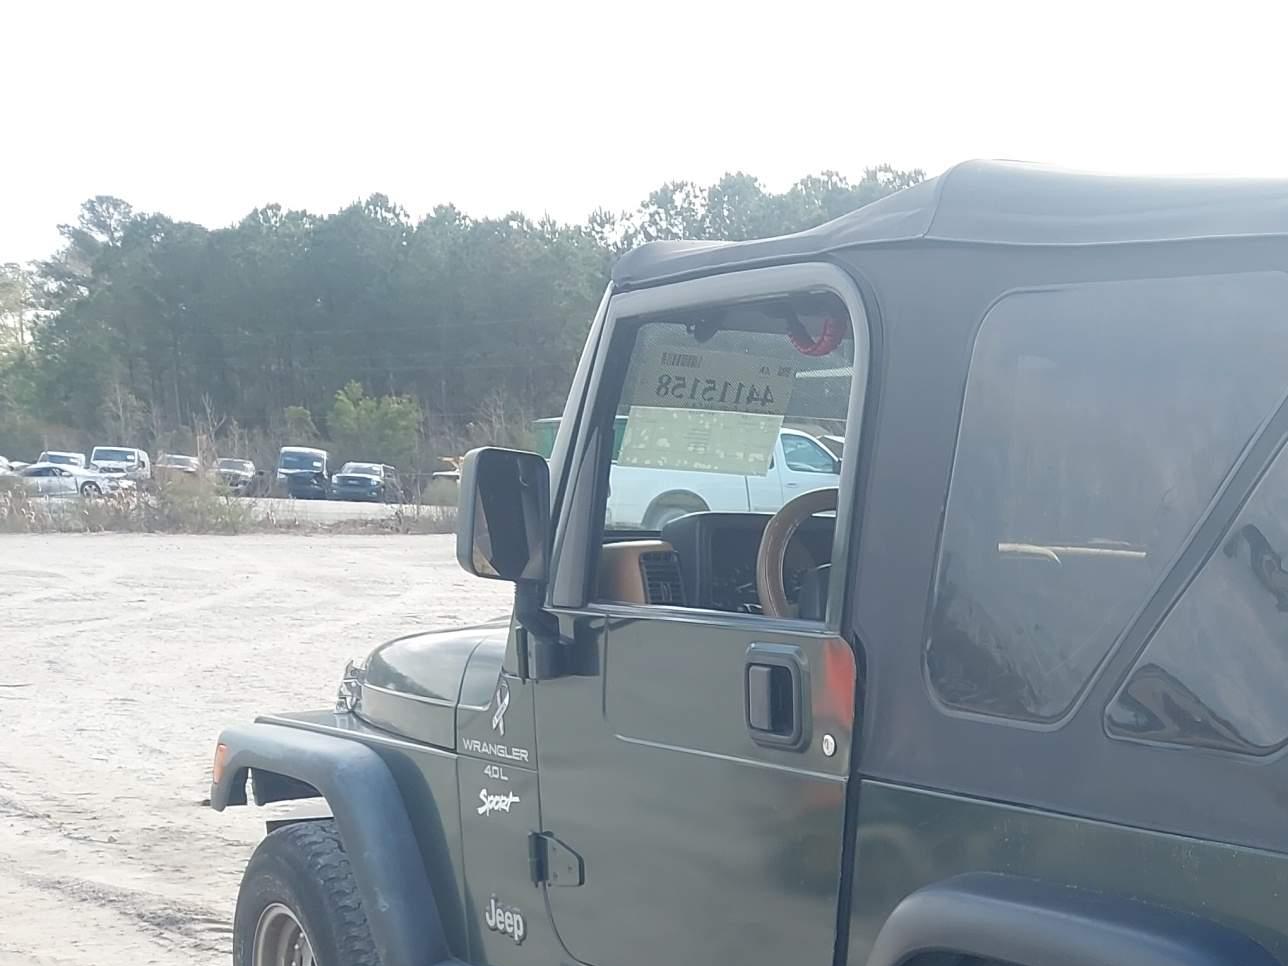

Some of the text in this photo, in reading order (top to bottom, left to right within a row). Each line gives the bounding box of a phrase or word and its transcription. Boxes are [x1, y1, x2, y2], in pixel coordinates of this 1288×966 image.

[462, 737, 529, 762] WRANGLER
[477, 789, 521, 816] Sport
[485, 898, 525, 942] Jeep
